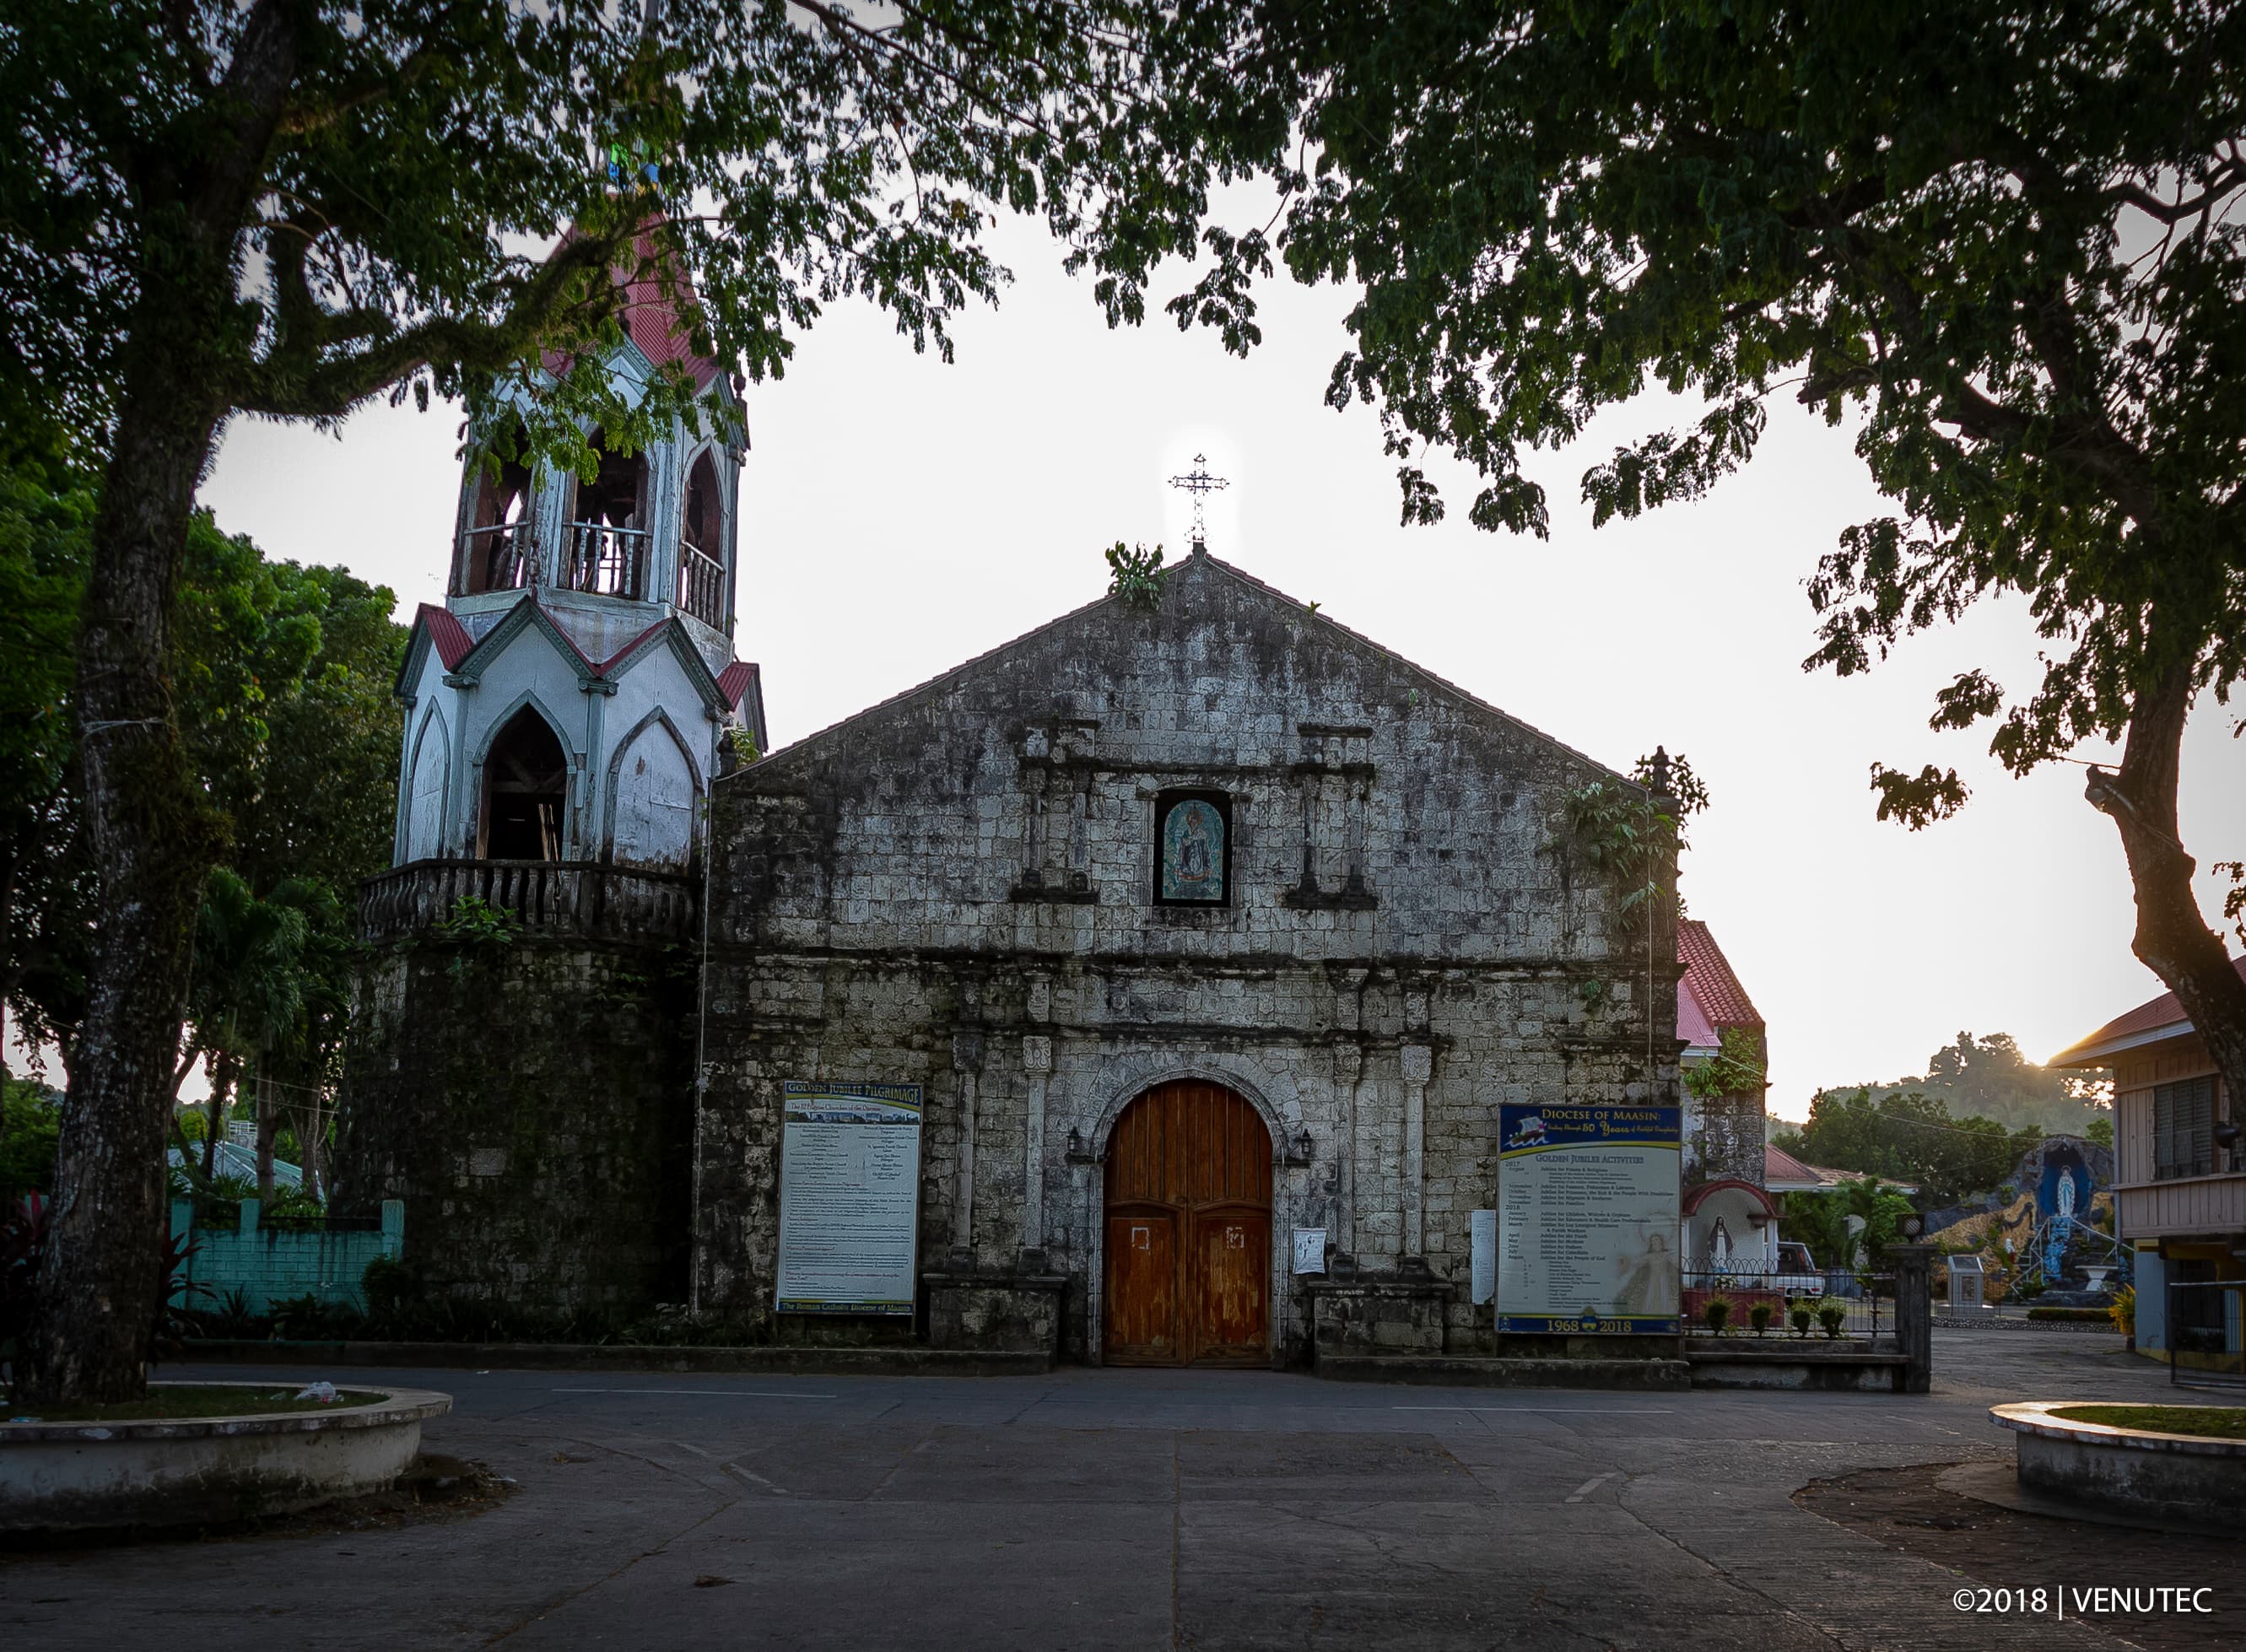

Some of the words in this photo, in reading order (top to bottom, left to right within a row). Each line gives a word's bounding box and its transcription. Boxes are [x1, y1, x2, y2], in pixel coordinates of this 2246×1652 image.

[788, 1083, 827, 1093] GOLDEN
[829, 1084, 863, 1094] JUBILEE
[866, 1085, 919, 1103] PILGRIMAGE
[1542, 1109, 1590, 1120] DIOCESE
[1595, 1110, 1609, 1120] OF
[1613, 1110, 1660, 1120] MAASIN:
[1582, 1123, 1595, 1132] 50
[1600, 1120, 1629, 1137] Years
[1535, 1154, 1568, 1163] GOLDEN
[1571, 1154, 1601, 1164] JUBILEE
[1602, 1155, 1644, 1164] ACTIVITIES
[1547, 1320, 1579, 1331] 1968
[1600, 1320, 1633, 1332] 2018
